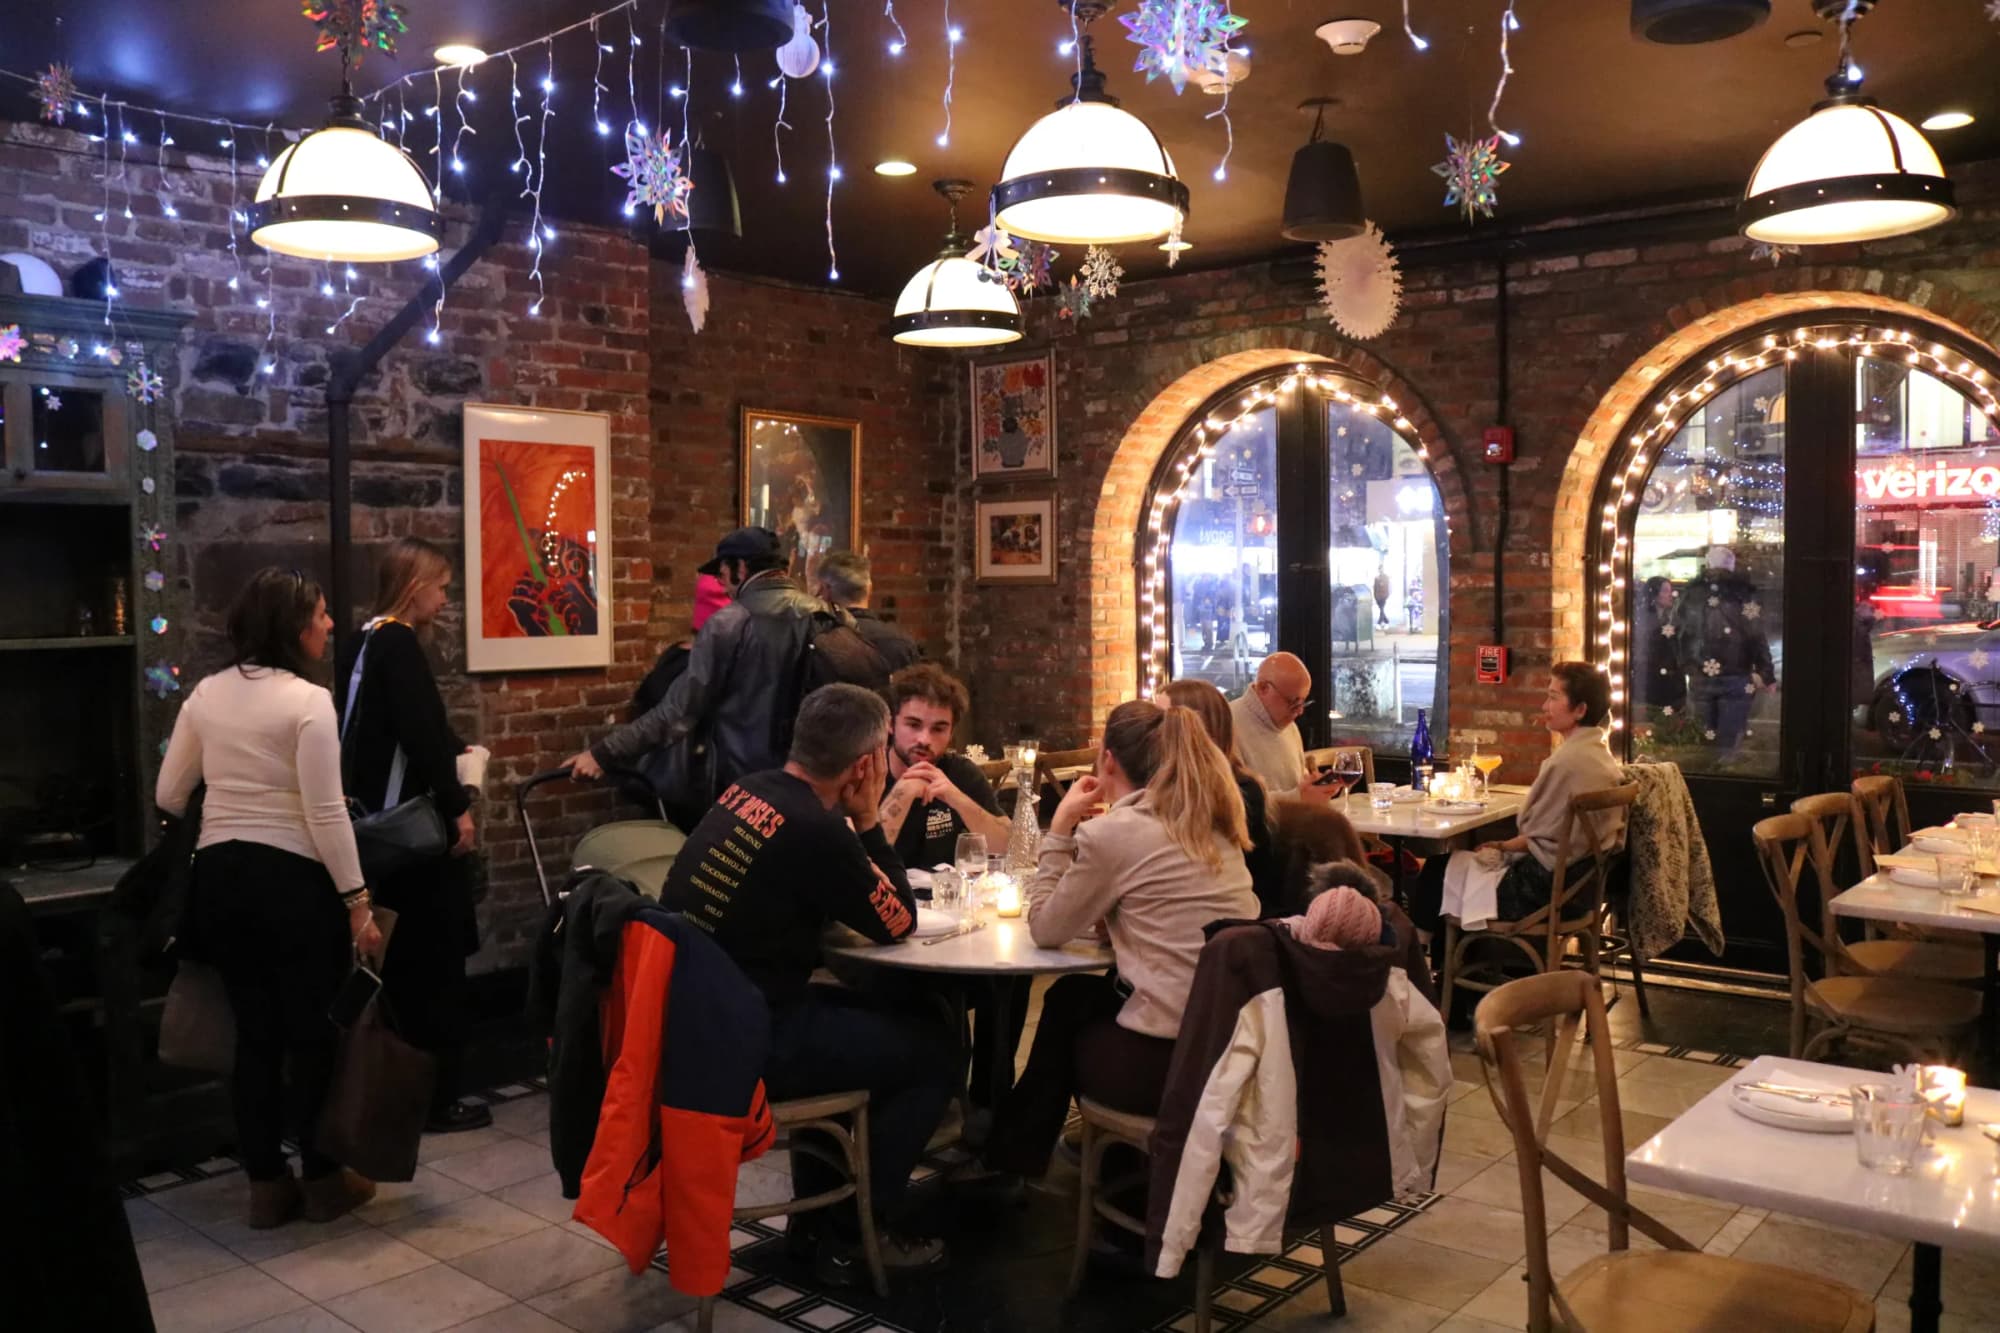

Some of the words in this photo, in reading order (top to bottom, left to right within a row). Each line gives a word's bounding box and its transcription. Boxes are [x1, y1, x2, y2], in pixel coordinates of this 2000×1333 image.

[1479, 647, 1500, 656] FIRE
[699, 861, 740, 890] STOCKHOLM
[707, 846, 750, 876] STOCKHOLM
